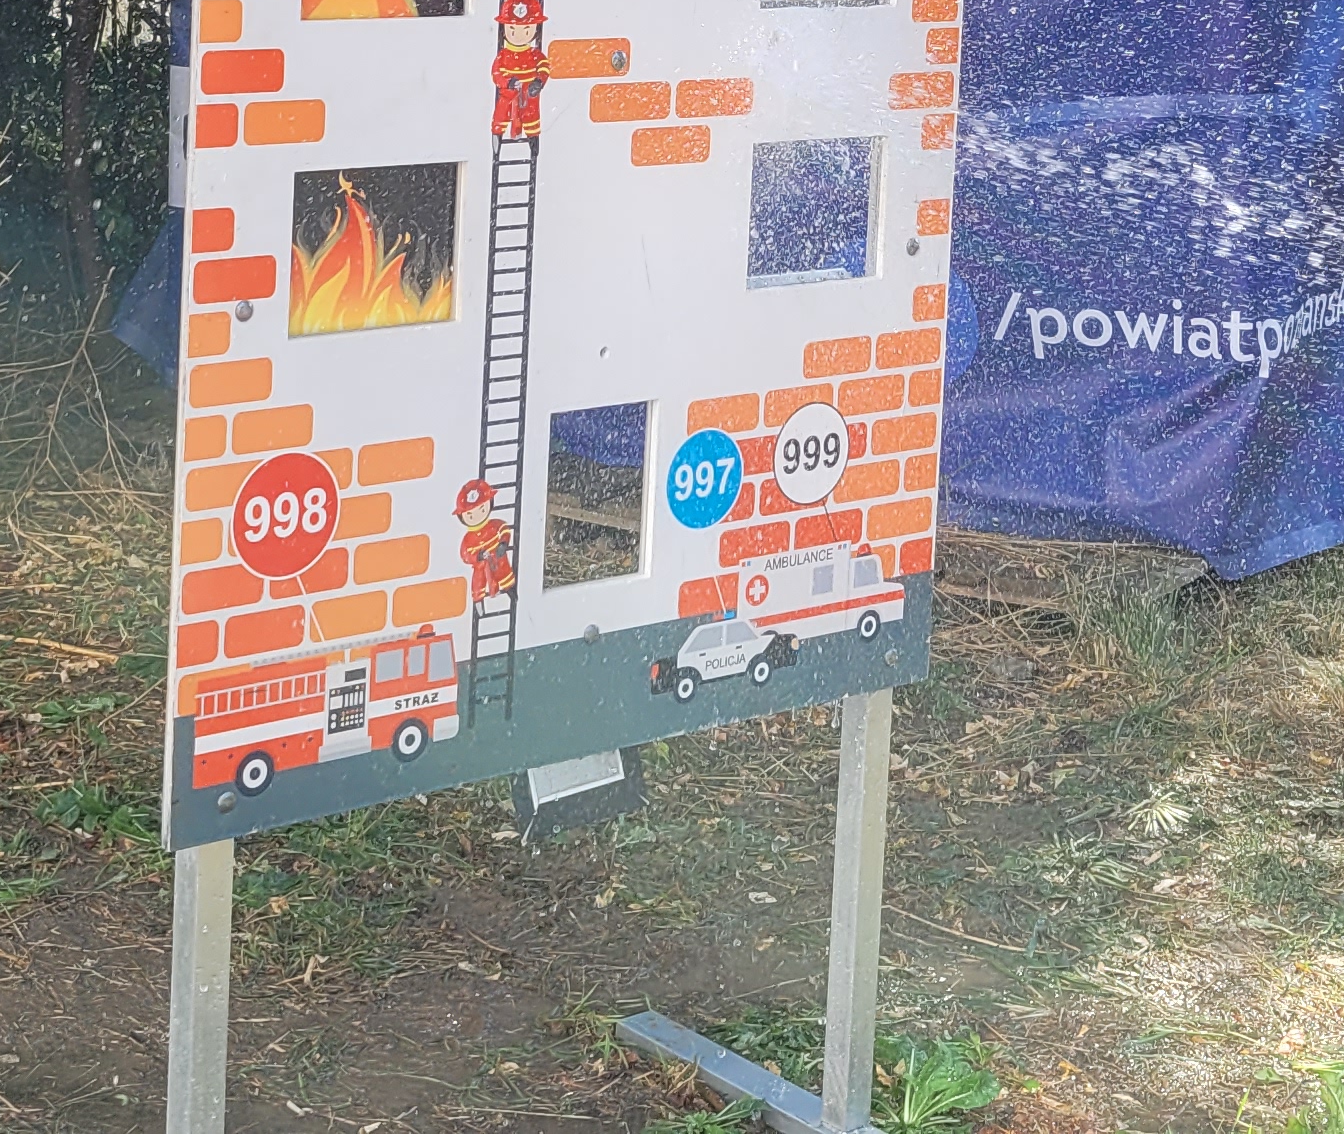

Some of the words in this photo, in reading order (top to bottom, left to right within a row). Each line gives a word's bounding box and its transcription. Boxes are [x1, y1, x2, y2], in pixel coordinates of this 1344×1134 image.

[782, 432, 842, 476] 999
[674, 457, 736, 502] 997
[243, 487, 328, 543] 998
[763, 547, 834, 572] AMBULANCE
[704, 652, 747, 672] POLICJA
